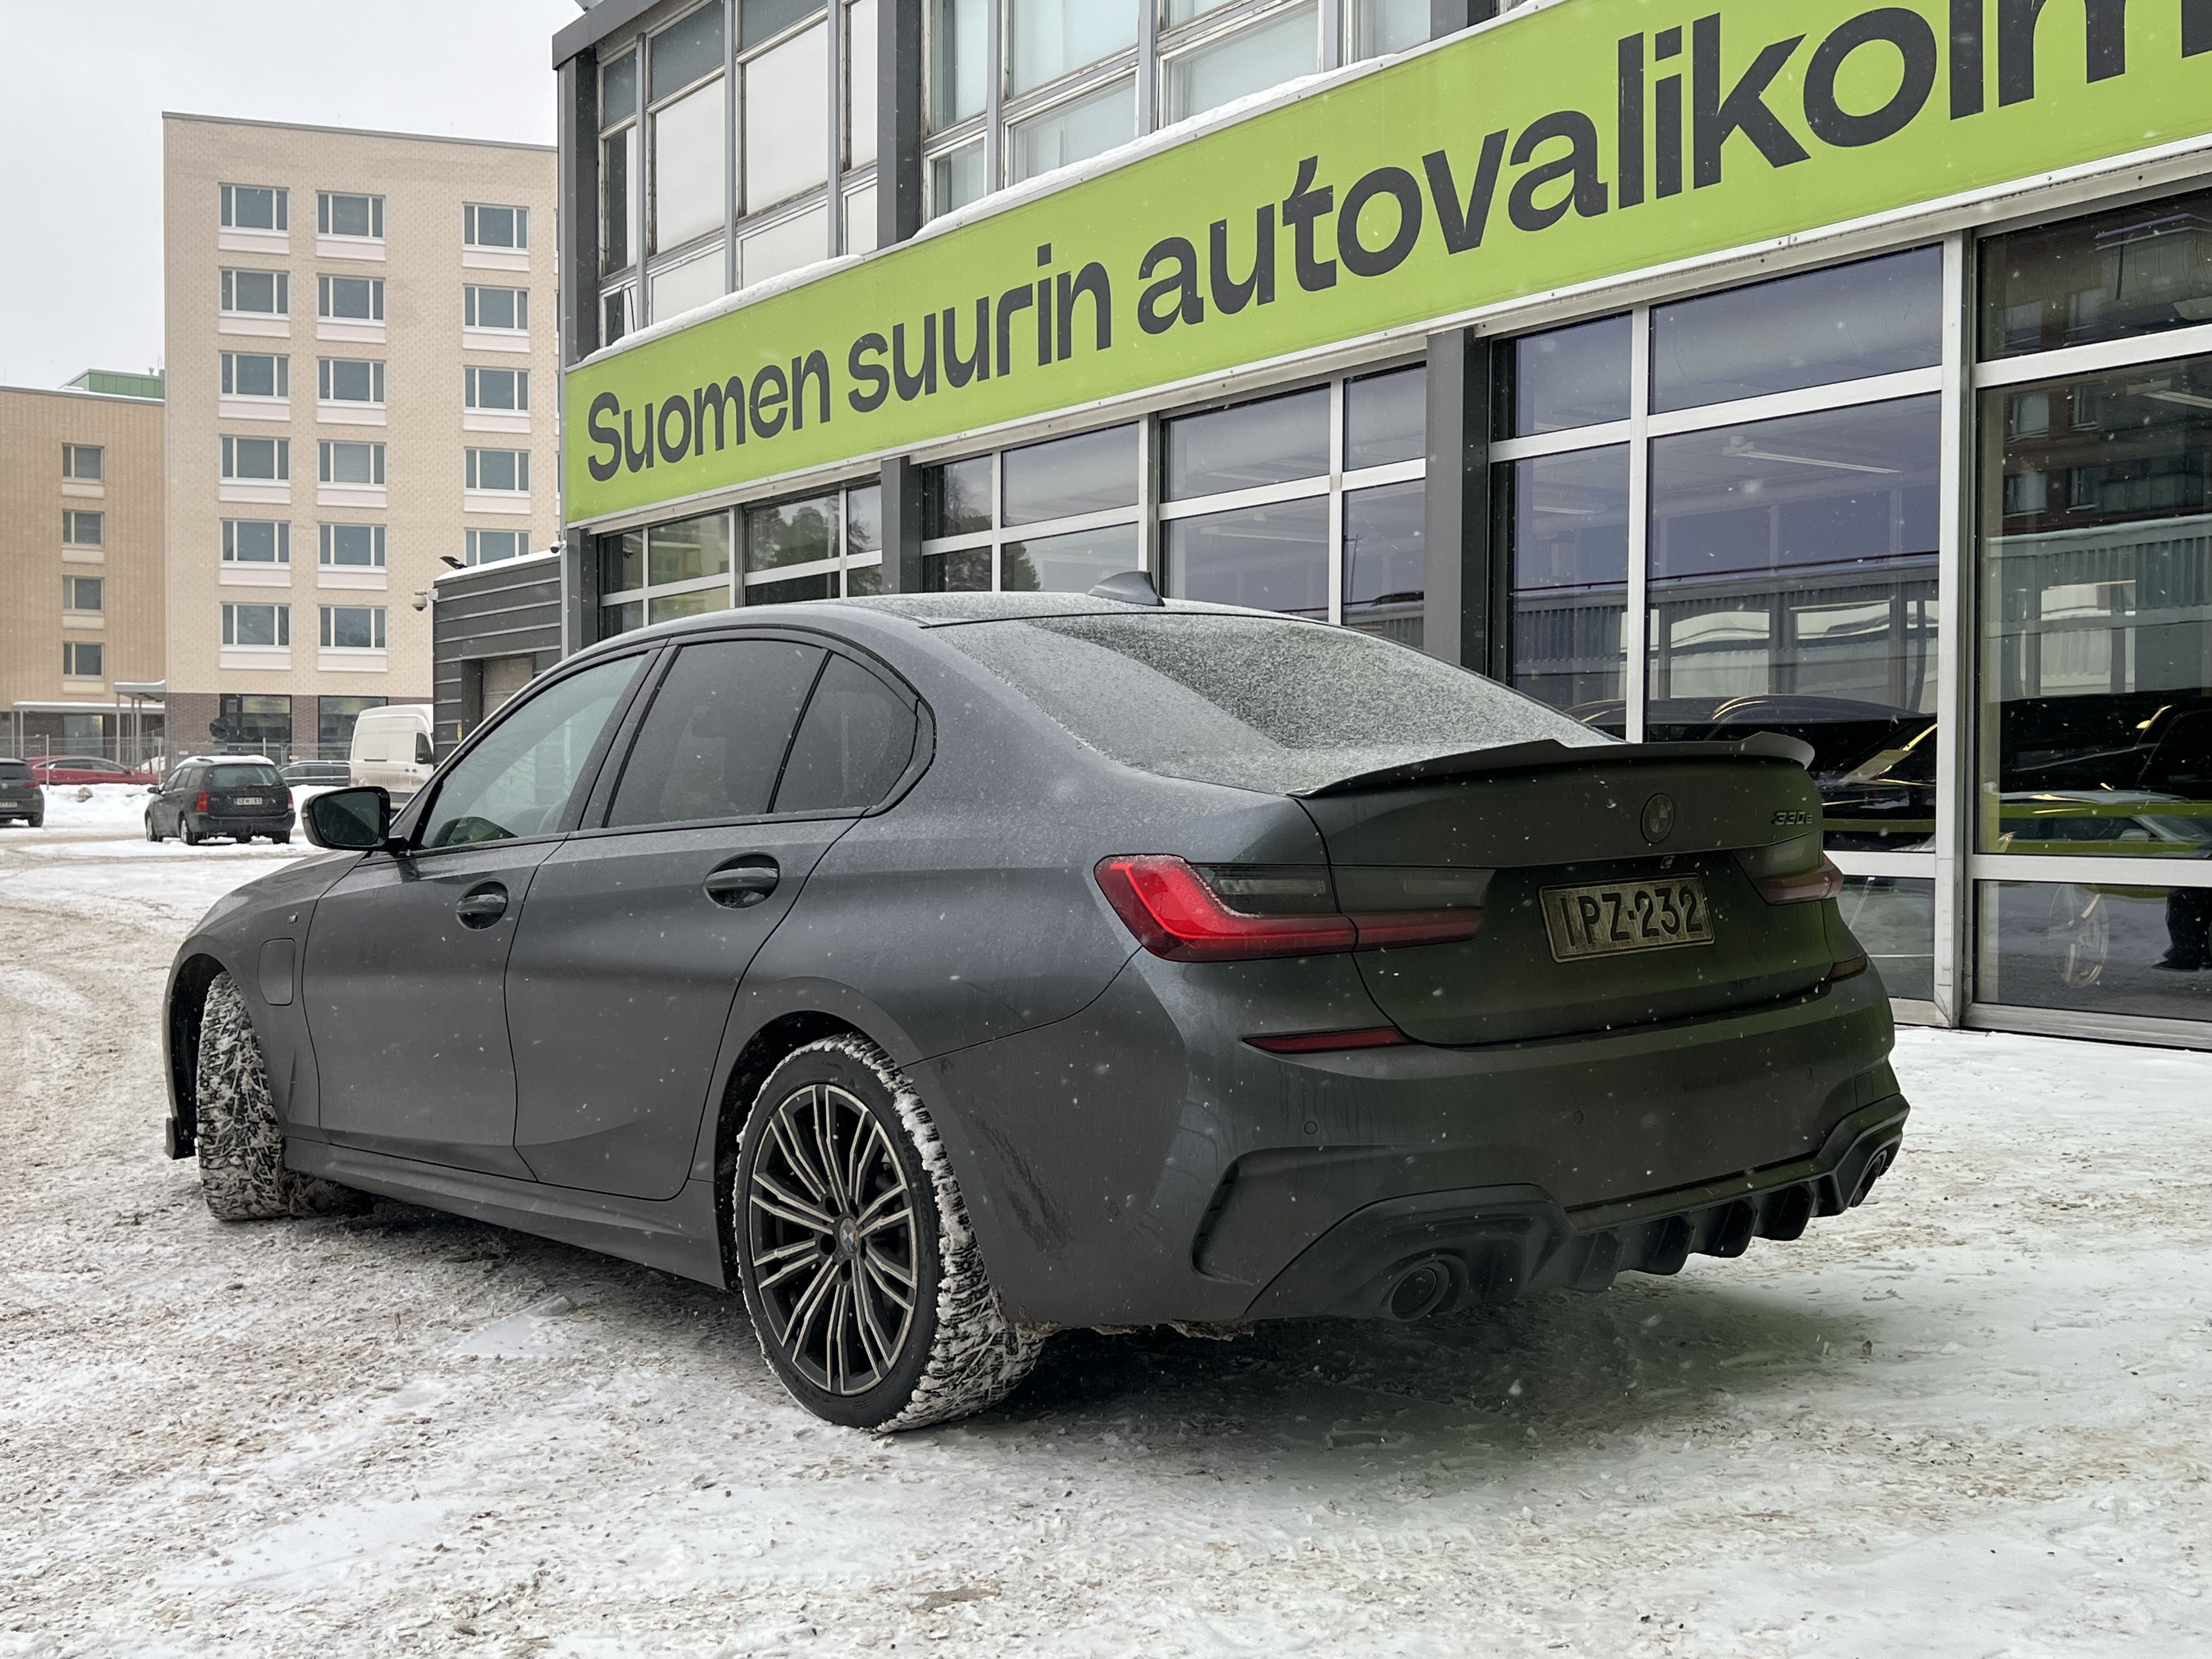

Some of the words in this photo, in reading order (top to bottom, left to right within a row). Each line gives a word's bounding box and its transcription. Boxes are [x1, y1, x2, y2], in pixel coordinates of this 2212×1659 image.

[588, 350, 831, 482] Suomen
[848, 242, 1111, 413] suurin
[1560, 885, 1703, 947] IPZ-232
